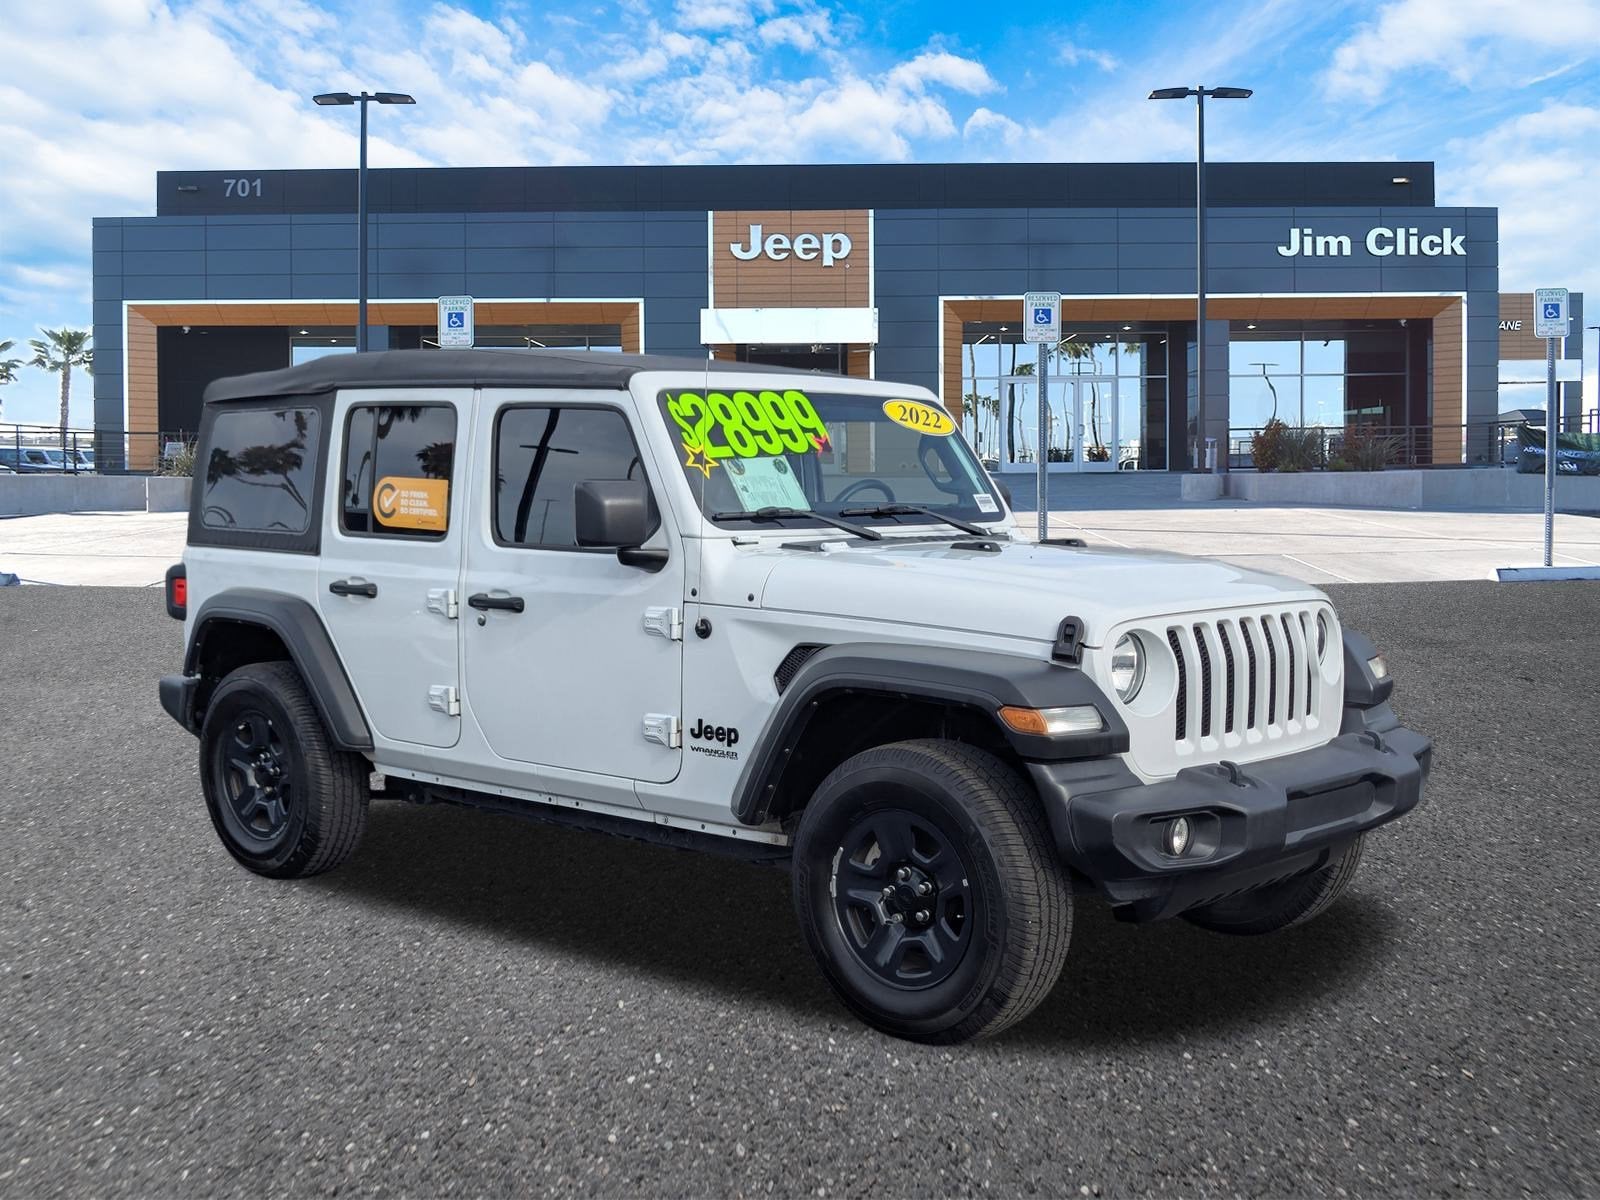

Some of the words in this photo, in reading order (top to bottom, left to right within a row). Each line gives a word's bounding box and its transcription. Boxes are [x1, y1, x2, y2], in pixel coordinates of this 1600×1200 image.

[224, 179, 261, 197] 701
[730, 224, 851, 267] Jeep
[1277, 228, 1351, 256] Jim
[1366, 227, 1467, 256] Click
[667, 391, 833, 458] $28999
[898, 405, 942, 429] 2022
[690, 718, 739, 747] Jeep
[690, 745, 738, 758] WRANGLER
